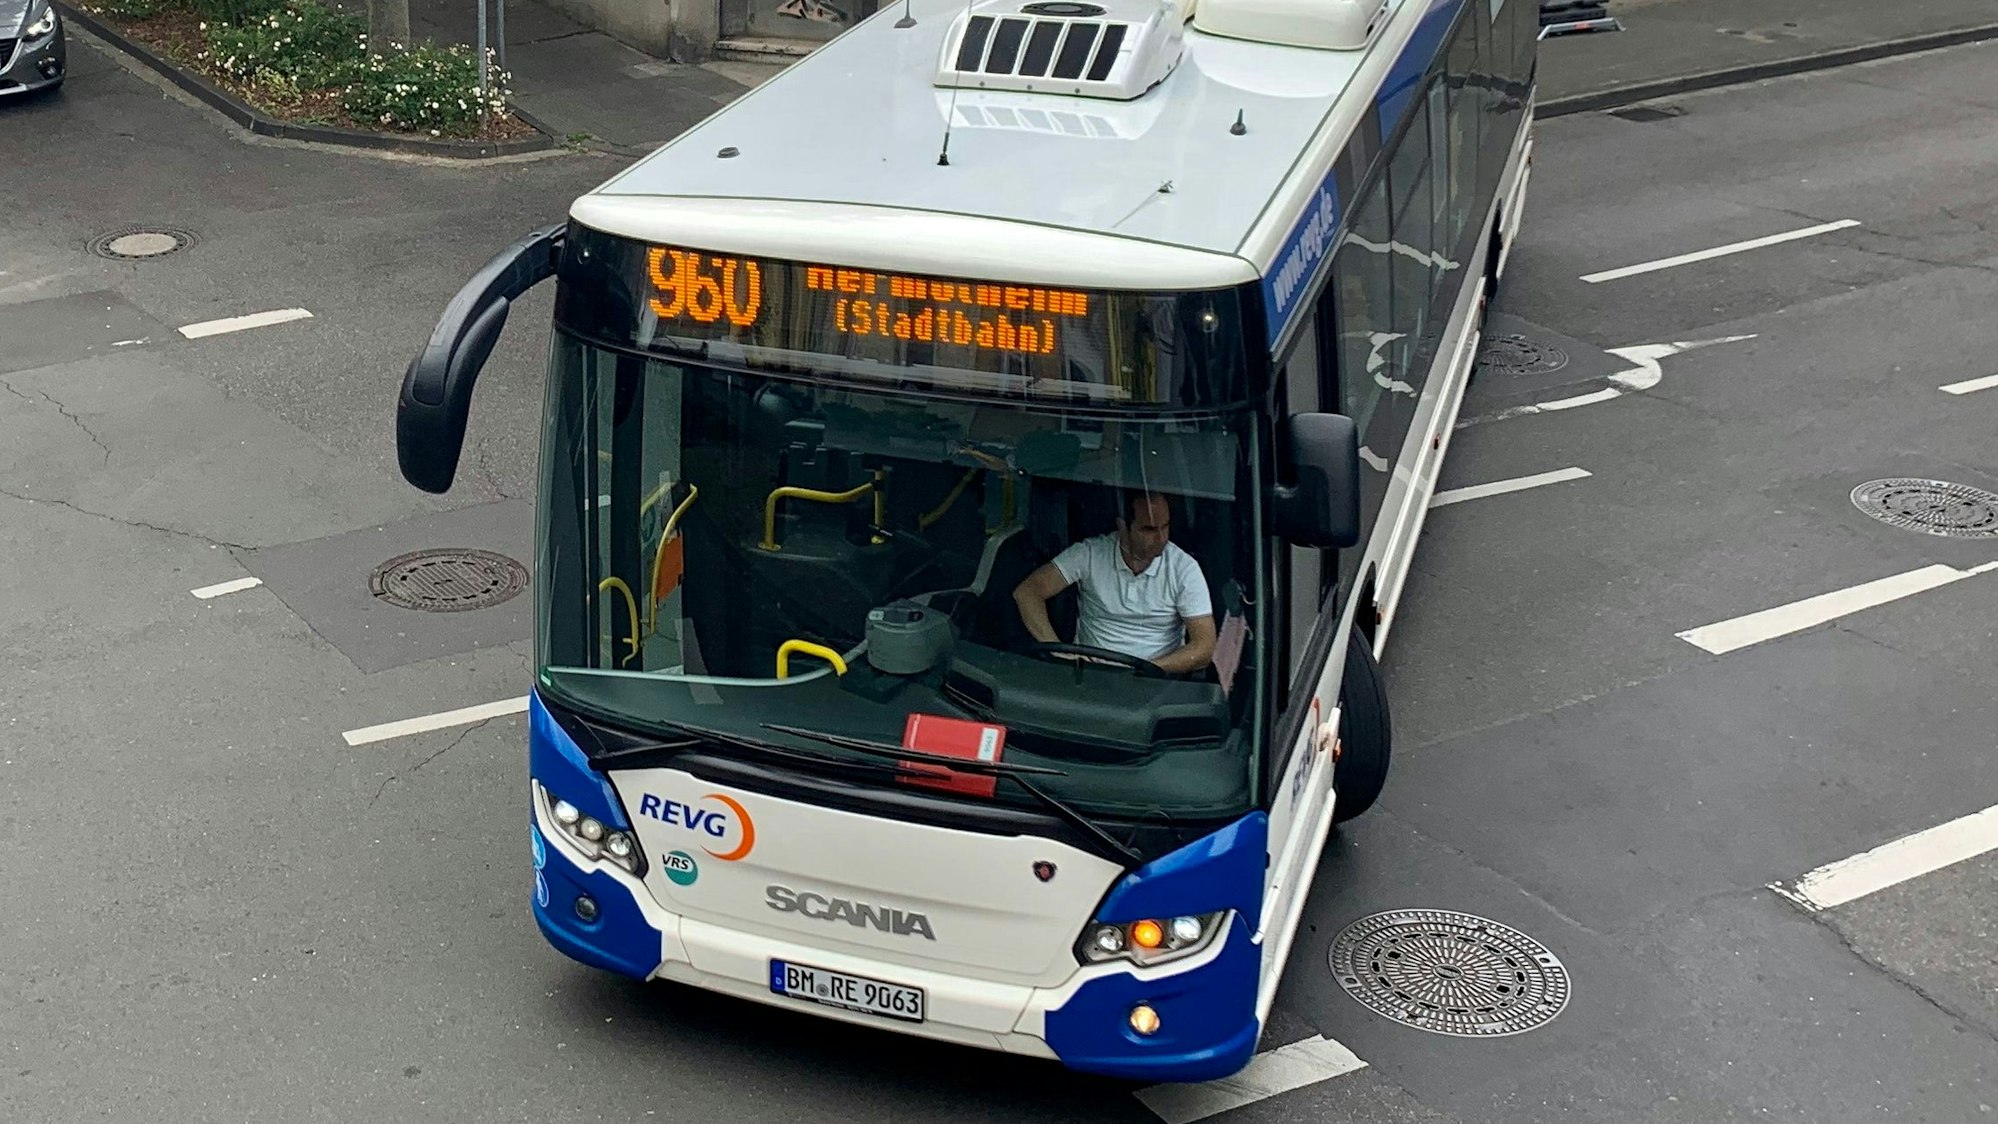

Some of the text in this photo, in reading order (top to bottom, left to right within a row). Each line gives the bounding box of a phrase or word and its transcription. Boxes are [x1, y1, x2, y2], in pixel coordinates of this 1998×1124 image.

[1272, 186, 1334, 313] www.revg.de
[649, 247, 761, 327] 960
[835, 298, 1055, 354] (Stadtbahn)
[639, 792, 727, 838] REVG
[661, 853, 690, 871] VRS
[764, 884, 938, 941] SCANIA
[786, 966, 815, 994] BM
[830, 976, 859, 1003] RE
[864, 983, 920, 1014] 9063
